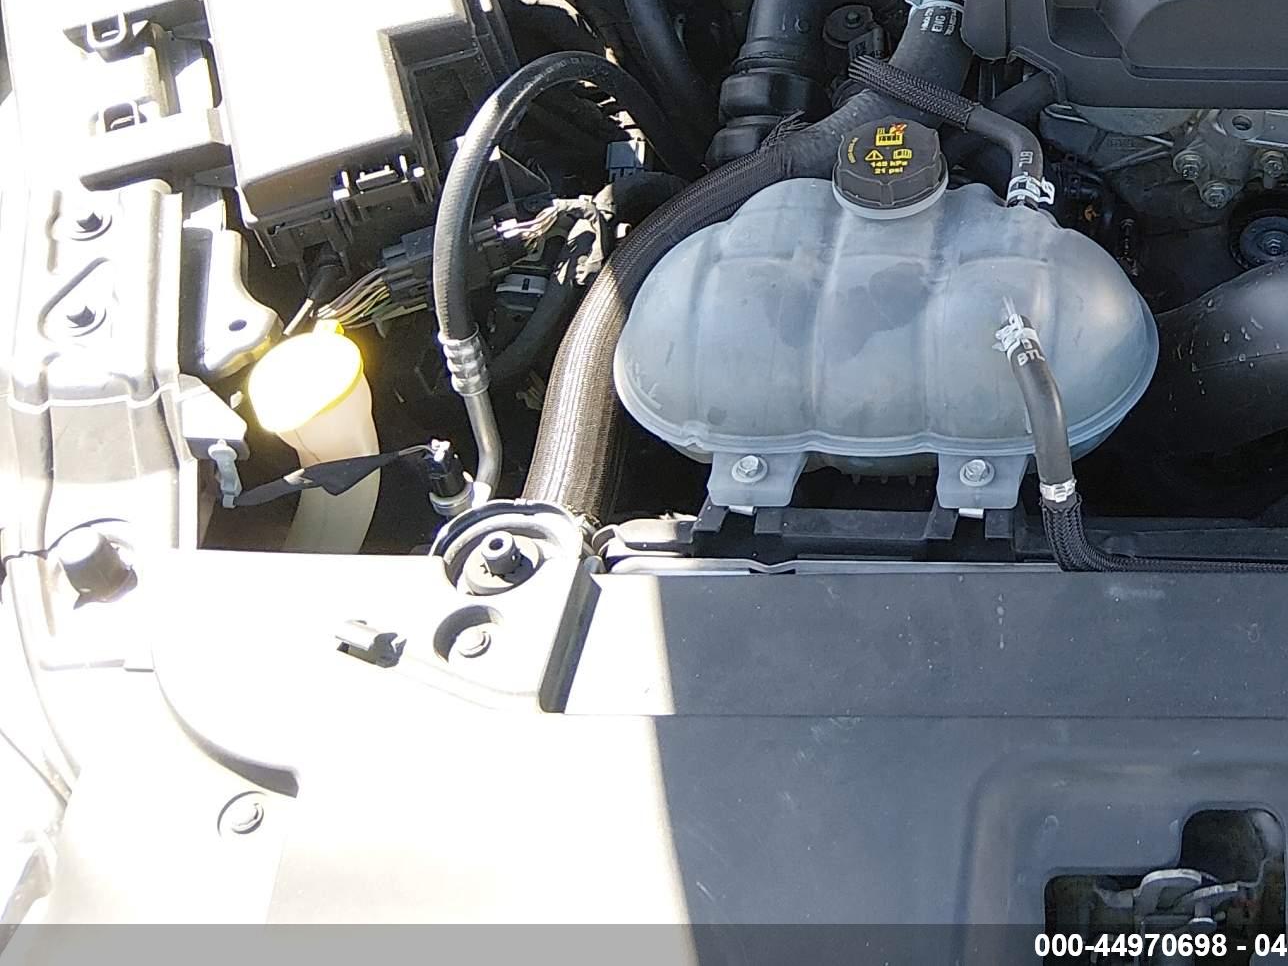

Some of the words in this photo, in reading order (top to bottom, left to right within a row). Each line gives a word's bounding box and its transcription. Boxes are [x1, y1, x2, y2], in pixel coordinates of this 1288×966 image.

[931, 15, 946, 33] ENG
[1018, 151, 1034, 168] BTL
[1017, 349, 1046, 366] BTL
